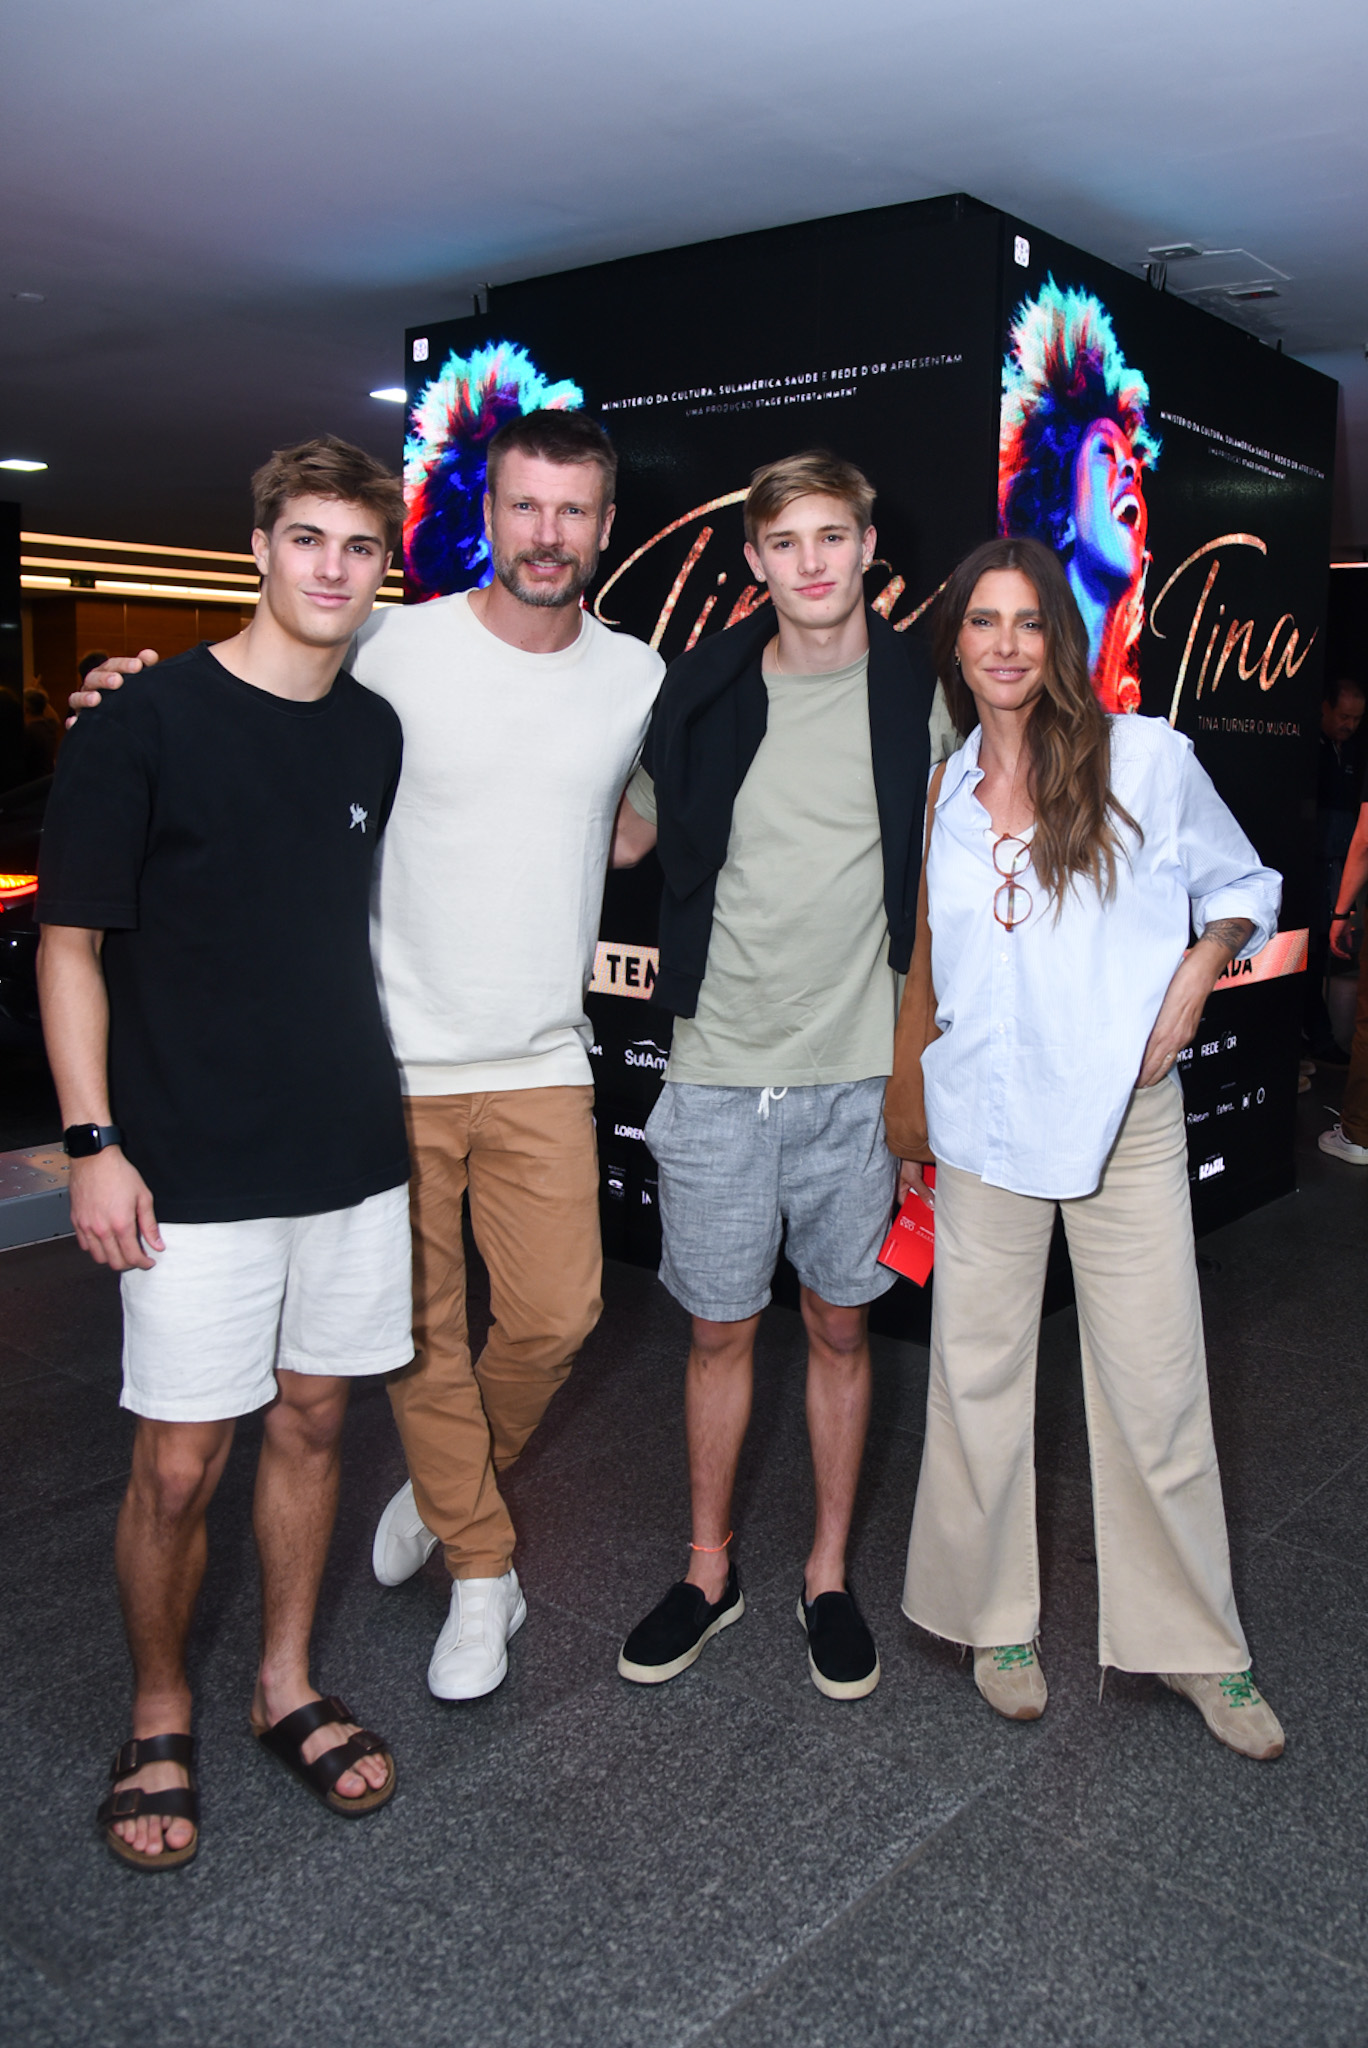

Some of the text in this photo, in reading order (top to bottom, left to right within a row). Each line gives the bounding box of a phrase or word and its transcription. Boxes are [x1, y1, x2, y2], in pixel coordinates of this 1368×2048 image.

[656, 393, 669, 404] DA
[831, 367, 858, 380] REDE
[756, 397, 782, 408] STAGE
[593, 486, 954, 653] Ti
[1150, 532, 1320, 729] Tina
[1198, 715, 1219, 731] TINA
[1221, 717, 1255, 733] TURNER
[1267, 721, 1301, 737] MUSICAL
